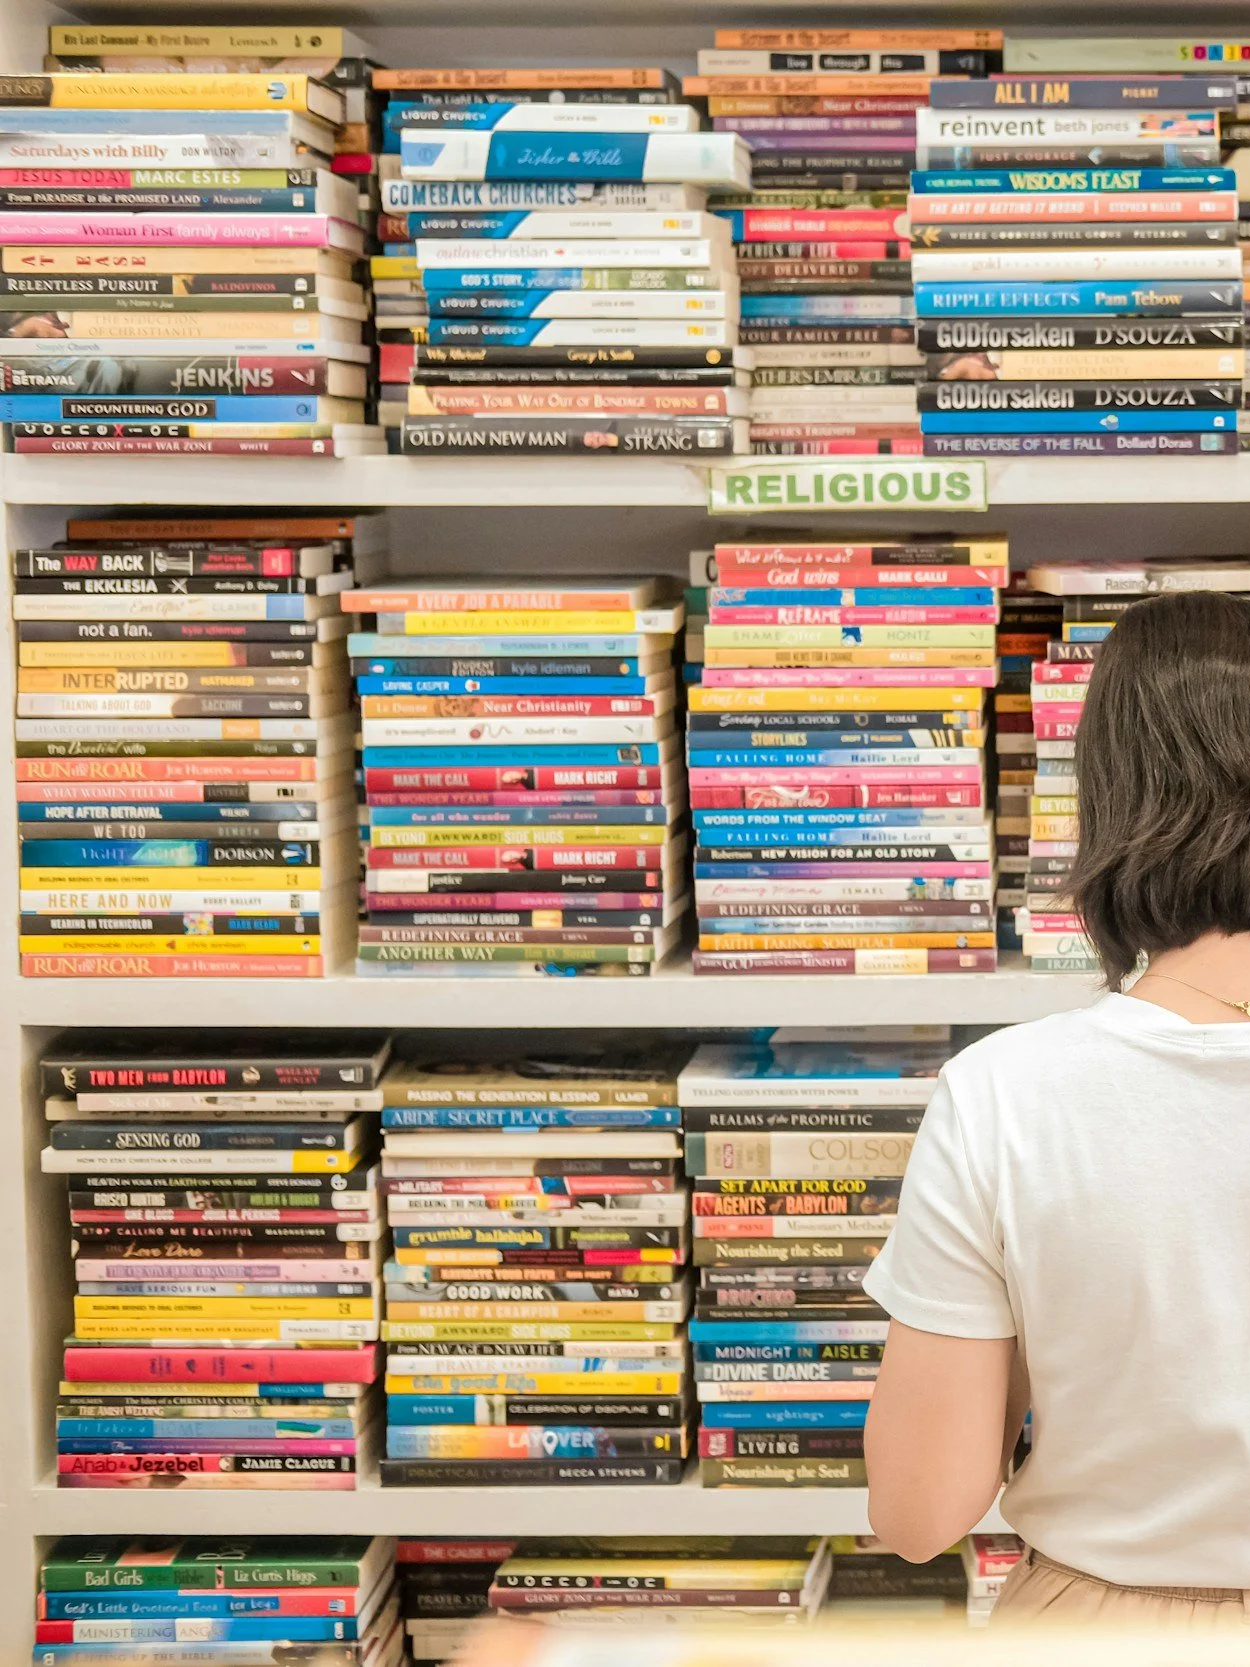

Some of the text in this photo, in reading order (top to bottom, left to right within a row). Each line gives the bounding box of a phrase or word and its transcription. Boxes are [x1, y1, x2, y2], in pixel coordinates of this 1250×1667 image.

[995, 84, 1069, 104] ALL I AM
[940, 116, 1129, 138] reinvent beth jones
[10, 144, 167, 160] Saturdays with Billy
[136, 171, 241, 184] MARC ESTES
[1092, 171, 1141, 188] FEAST
[390, 183, 579, 206] COMEBACK CHURCHES
[82, 224, 270, 241] Woman First family always
[7, 278, 159, 292] RELENTLESS PURSUIT
[933, 292, 1081, 308] RIPPLE EFFECTS
[1095, 292, 1182, 305] Pam Tebow
[937, 324, 1196, 348] GODforsaken D'SOUZA
[12, 374, 76, 386] BETRAYAL
[171, 367, 274, 388] JENKINS
[937, 386, 1196, 409] GODforsaken D'SOUZA
[70, 402, 208, 416] ENCOUNTERING GOD
[410, 432, 567, 446] OLD MAN NEW MAN
[625, 435, 692, 450] STRANG
[726, 472, 971, 504] RELIGIOUS
[36, 555, 144, 571] The WAY BACK
[767, 570, 839, 585] God wins
[879, 571, 948, 583] MARK GALLI
[1106, 578, 1147, 590] Raising
[63, 579, 157, 592] THE EKKLESIA
[79, 623, 152, 636] not a fan.
[1057, 646, 1094, 659] MAX
[512, 662, 591, 675] kyle idleman
[62, 672, 188, 689] INTERRUPTED
[484, 700, 592, 714] Near Christianity
[46, 806, 162, 819] HOPE AFTER BETRAYAL
[703, 814, 887, 824] WORDS FROM THE WINDOW SEAT
[214, 847, 274, 861] DOBSON
[762, 848, 936, 859] NEW VISION FOR AN OLD STORY
[48, 894, 172, 907] HERE AND NOW
[377, 948, 495, 960] ANOTHER WAY
[90, 1070, 114, 1086] TWO
[118, 1070, 144, 1085] MEN
[173, 1069, 226, 1085] BABYLON
[392, 1111, 557, 1125] ABIDE SECRET PLACE
[710, 1115, 872, 1126] REALMS PROPHETIC
[116, 1133, 200, 1148] SENSING GOD
[721, 1180, 866, 1192] SET APART FOR GOD
[715, 1197, 847, 1215] AGENTS BABYLON
[716, 1245, 843, 1260] Nourishing the Seed
[447, 1286, 544, 1299] GOOD WORK
[715, 1347, 869, 1359] MIDNIGHT IN AISLE
[713, 1364, 830, 1381] DIVINE DANCE
[509, 1431, 593, 1451] LAYOVER
[738, 1442, 799, 1453] LIVING
[72, 1458, 204, 1472] Ahab Jezebel
[241, 1459, 335, 1469] JAMIE CLAGUE
[85, 1572, 144, 1586] Bad Girls
[234, 1570, 316, 1584] Liz Curtis Higgs
[79, 1626, 173, 1639] MINISTERING
